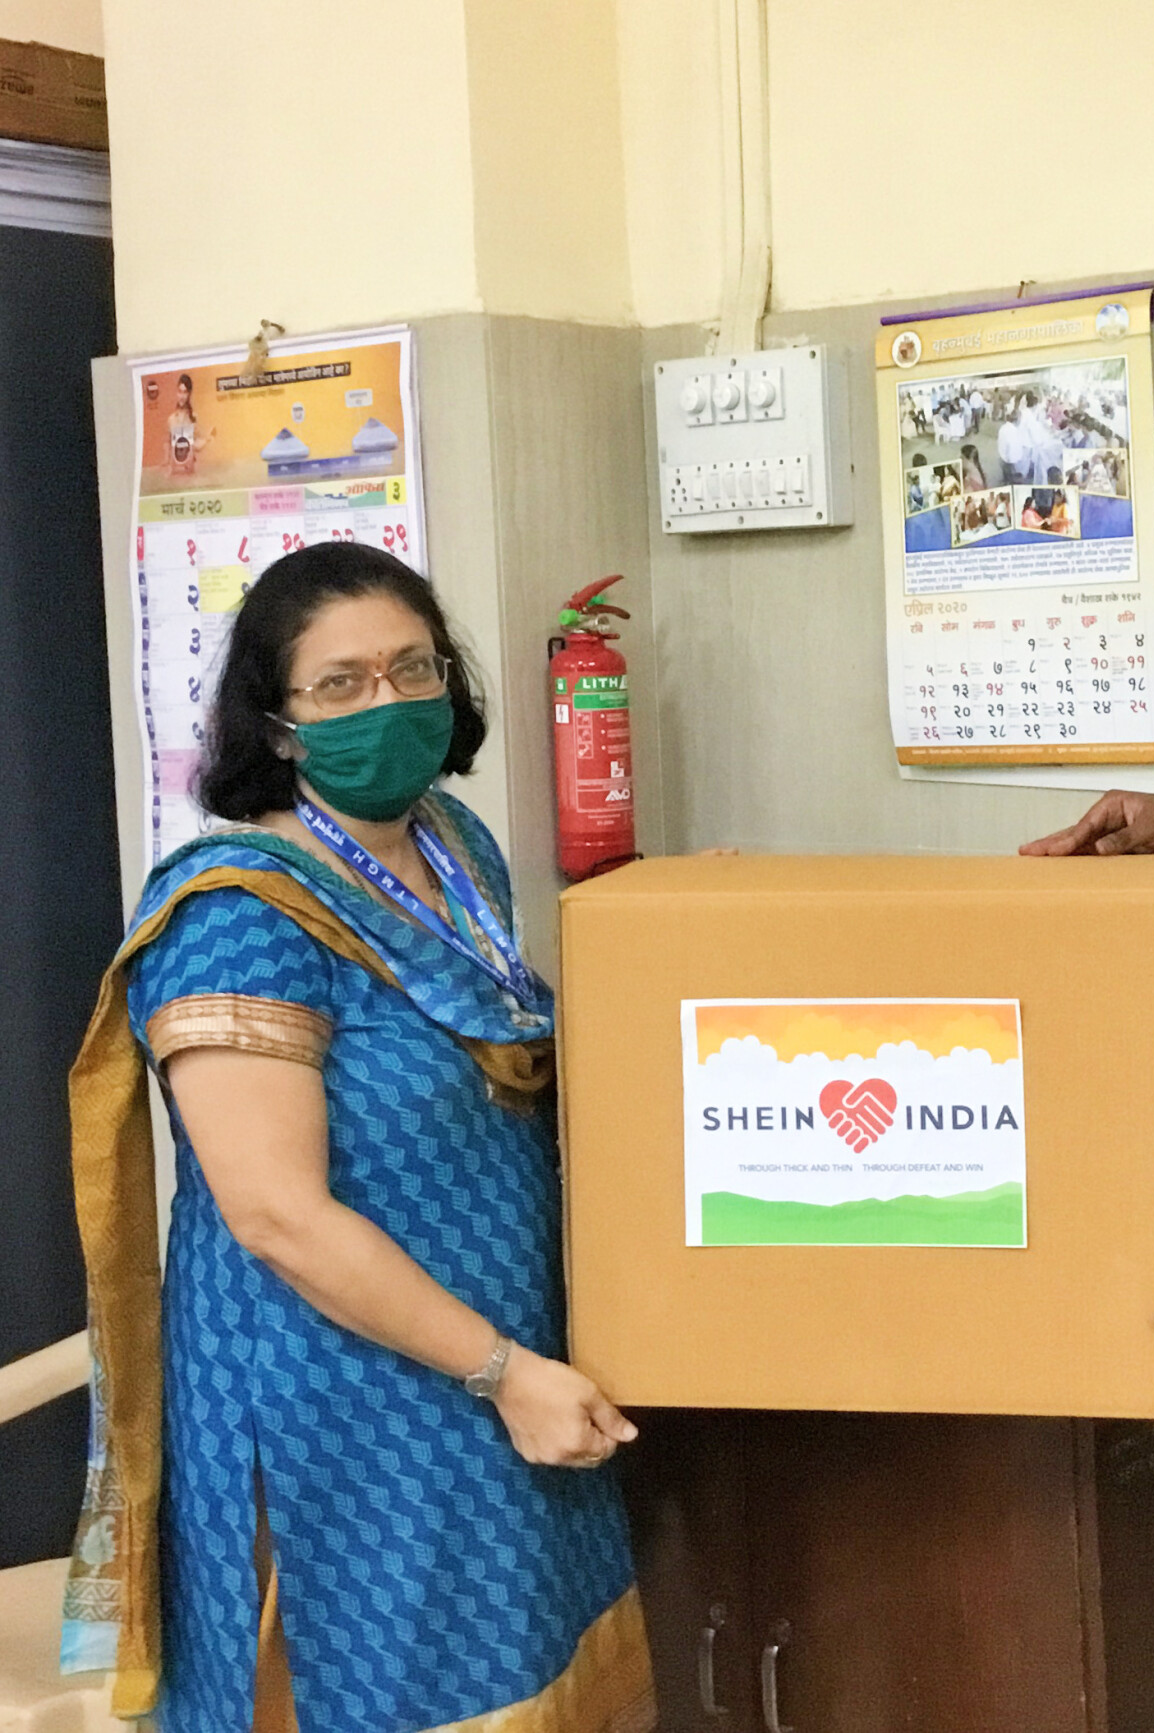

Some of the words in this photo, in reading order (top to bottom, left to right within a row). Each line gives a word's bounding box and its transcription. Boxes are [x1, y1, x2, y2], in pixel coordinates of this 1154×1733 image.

[189, 500, 222, 515] २०२०
[187, 539, 196, 566] १
[237, 536, 251, 563] ८
[937, 602, 967, 615] २०२०
[1028, 638, 1035, 651] १
[1063, 637, 1071, 650] २
[1099, 634, 1107, 649] ३
[1136, 634, 1144, 647] ४
[926, 664, 934, 676] ५
[960, 663, 967, 676] ६
[994, 661, 1002, 674] ७
[1029, 660, 1036, 674] ८
[1065, 658, 1072, 674] ९
[1090, 657, 1108, 670] १०
[1127, 656, 1145, 669] ११
[919, 686, 935, 698] १२
[952, 684, 969, 699] १३
[987, 683, 1003, 696] १४
[1021, 682, 1037, 695] १५
[1056, 680, 1074, 695] १६
[1092, 679, 1110, 692] १७
[1128, 678, 1146, 691] १८
[921, 707, 937, 721] १९
[954, 705, 971, 718] २०
[988, 704, 1004, 717] २१
[1022, 703, 1039, 716] २२
[1057, 702, 1075, 717] २३
[1093, 701, 1111, 714] २४
[1130, 700, 1147, 713] २५
[923, 727, 940, 740] २६
[956, 726, 973, 739] २७
[990, 725, 1007, 738] २८
[1024, 724, 1041, 738] २९
[1059, 723, 1077, 736] ३०
[703, 1106, 814, 1131] SHEIN
[906, 1104, 1019, 1130] INDIA
[738, 1163, 782, 1173] THROUGH
[783, 1163, 809, 1173] THICK
[811, 1163, 830, 1172] AND
[832, 1163, 853, 1172] THIN
[863, 1163, 906, 1172] THROUGH
[907, 1163, 941, 1172] DEFEAT
[943, 1163, 964, 1172] AND
[965, 1163, 983, 1172] WIN
